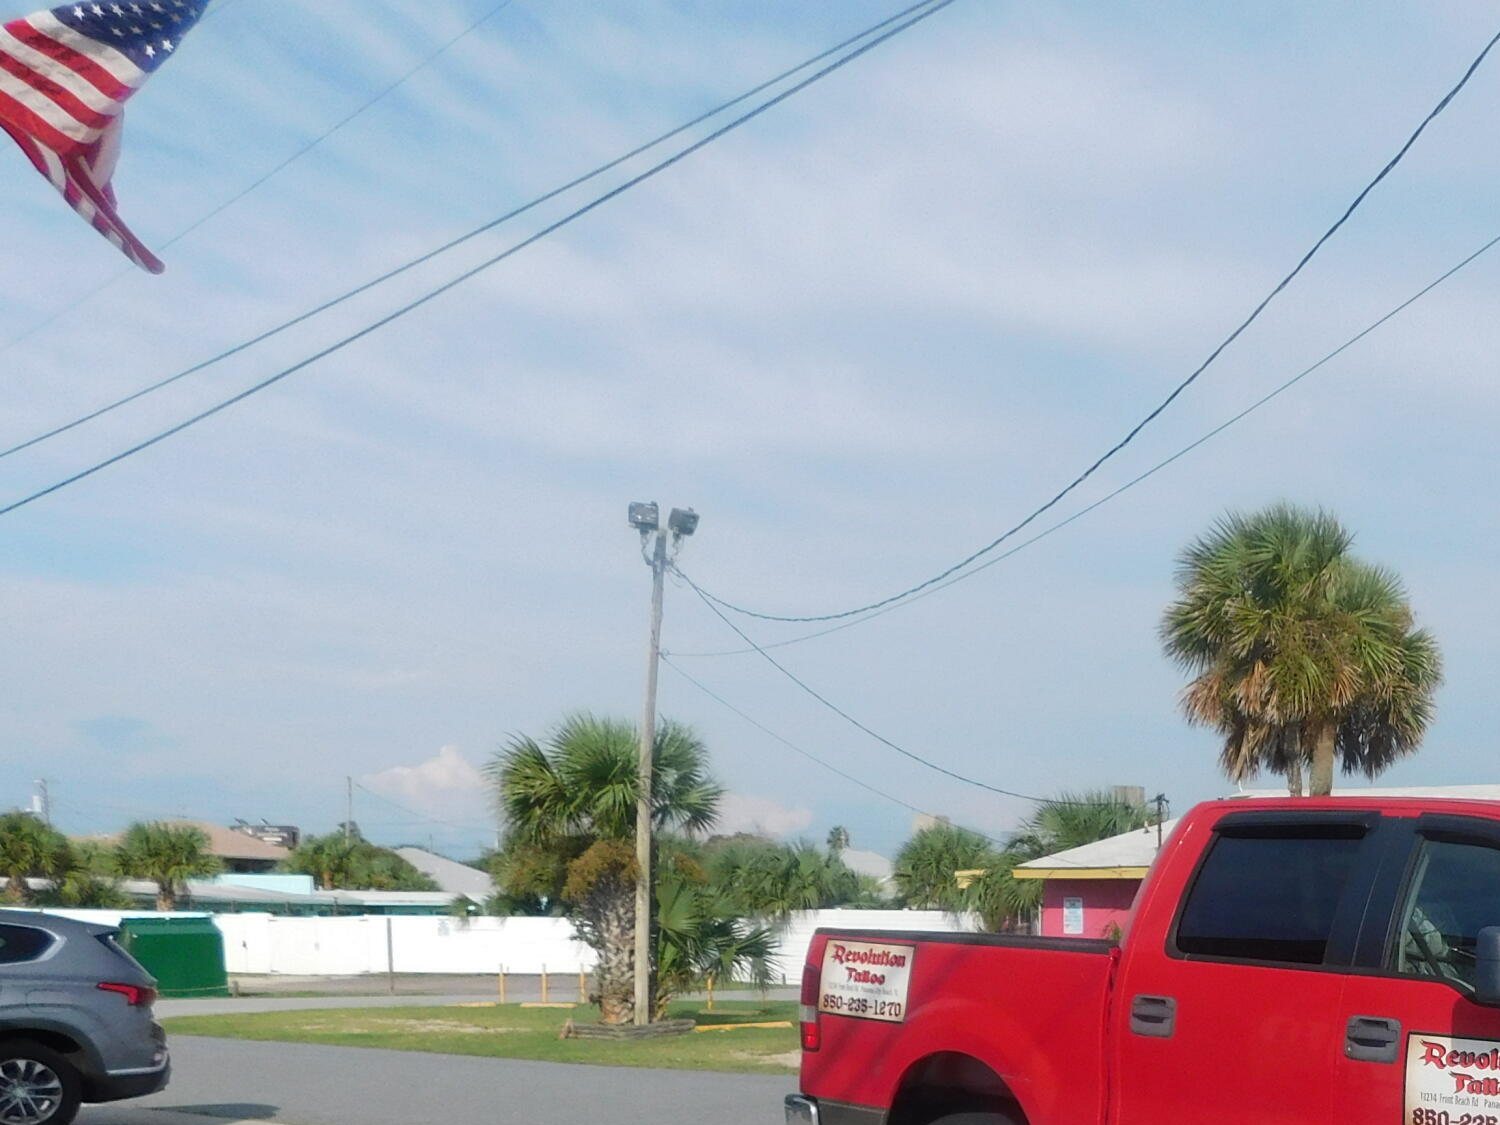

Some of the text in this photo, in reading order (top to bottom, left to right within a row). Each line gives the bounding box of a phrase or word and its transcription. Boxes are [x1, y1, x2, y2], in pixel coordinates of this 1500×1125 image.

[831, 944, 906, 968] Revolution
[845, 966, 886, 985] Tattoo
[823, 993, 901, 1017] 850-235-1270
